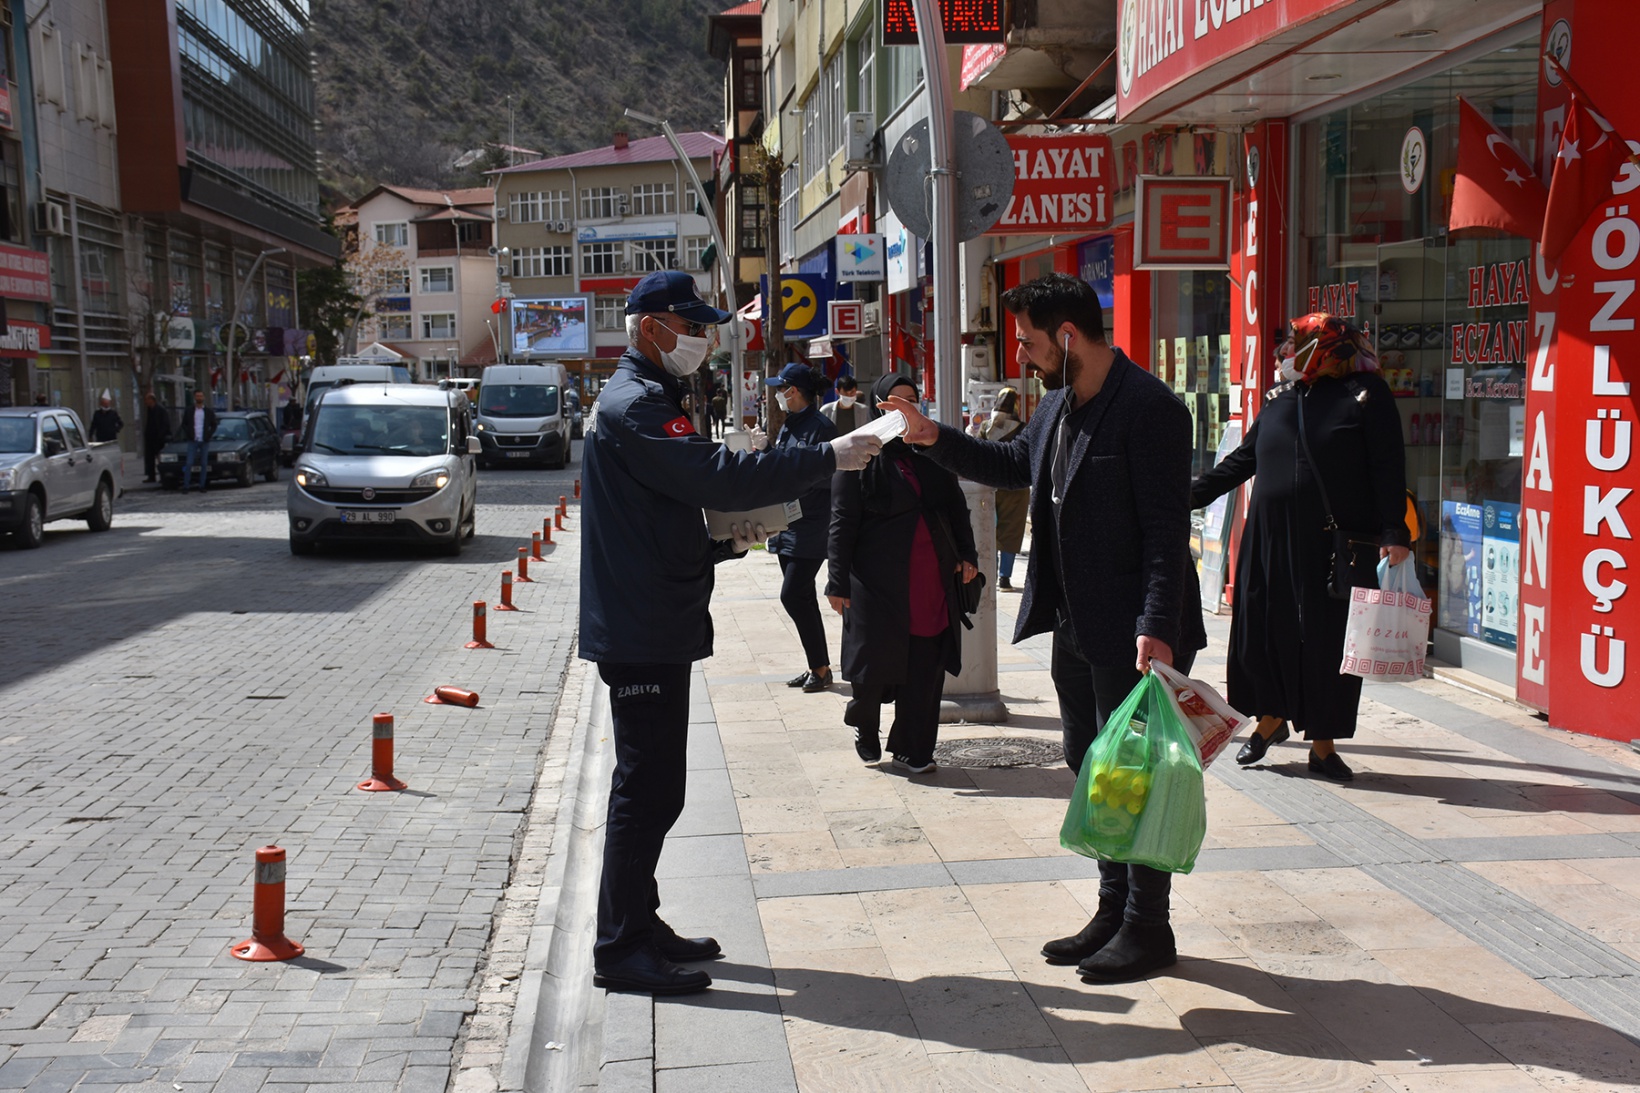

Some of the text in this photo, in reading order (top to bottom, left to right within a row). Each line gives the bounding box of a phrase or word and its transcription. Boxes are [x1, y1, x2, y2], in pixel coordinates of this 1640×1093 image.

[886, 0, 1000, 31] ANTARCI
[1013, 147, 1104, 180] HAYAT
[1000, 185, 1106, 225] ZANESİ
[1160, 194, 1211, 250] E
[841, 269, 855, 277] Türk
[1467, 259, 1530, 308] HAYA
[1308, 281, 1358, 318] HAYAT
[838, 308, 856, 330] E
[1486, 378, 1519, 399] Kerem
[346, 512, 393, 521] 29 AL 990
[617, 684, 661, 698] ZABITA
